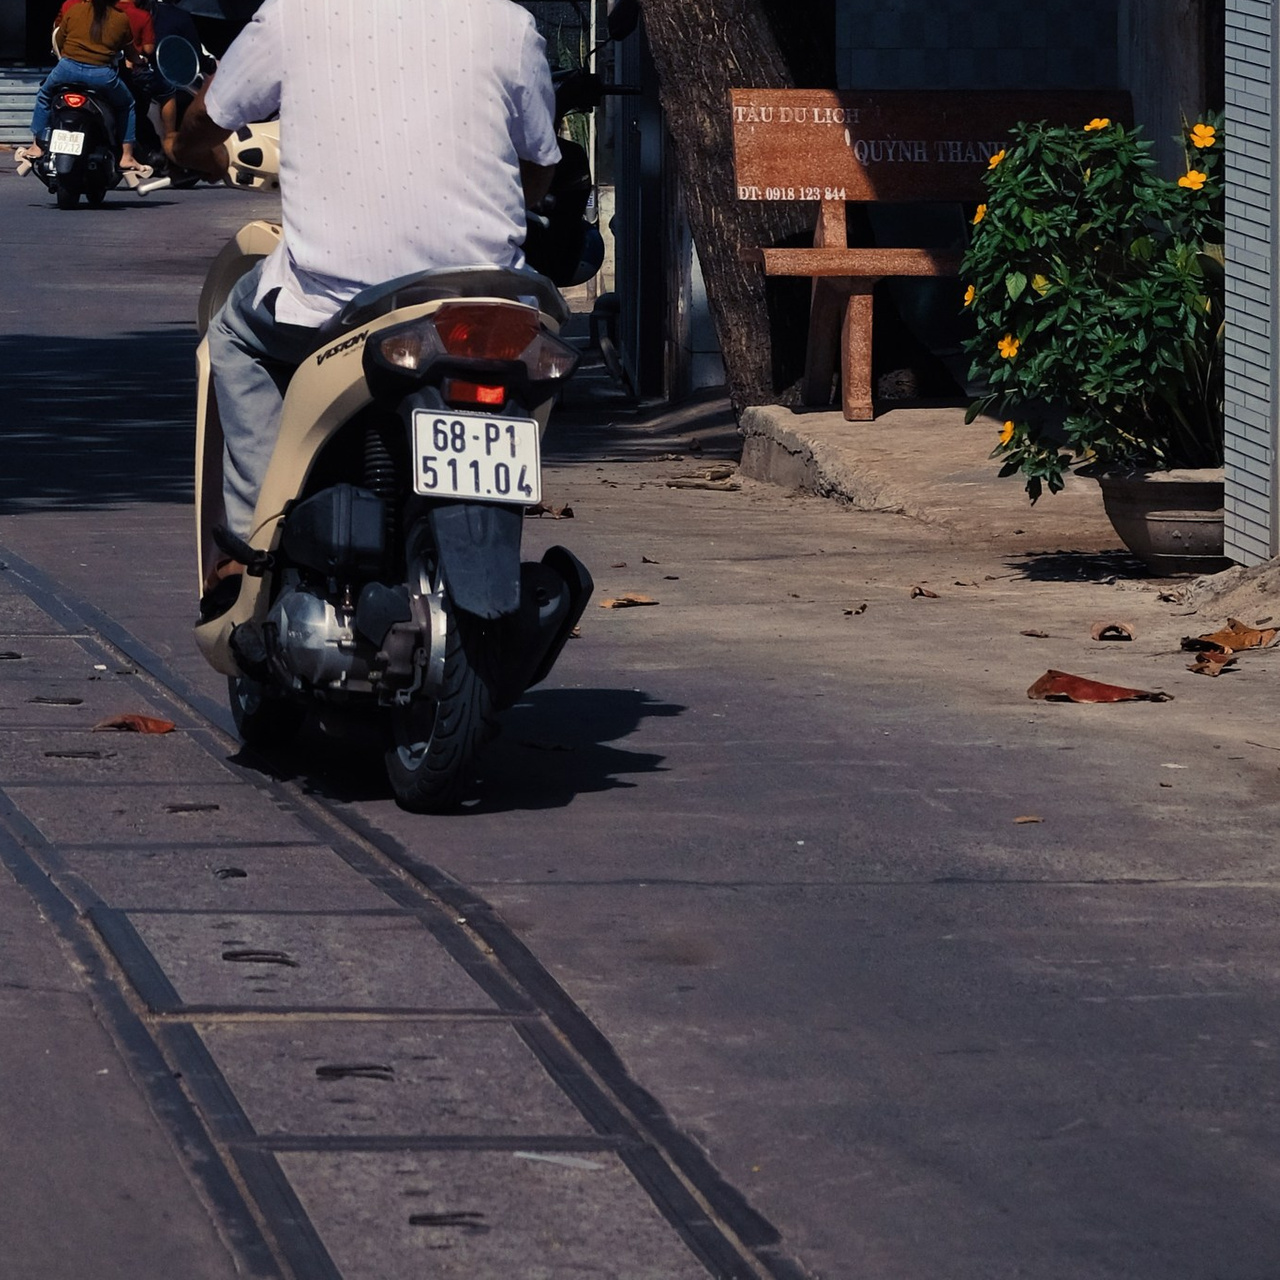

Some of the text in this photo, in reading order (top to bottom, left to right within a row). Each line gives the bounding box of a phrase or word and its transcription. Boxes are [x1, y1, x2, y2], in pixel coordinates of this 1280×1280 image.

[734, 102, 860, 127] TÀU DU LỊCH
[854, 133, 928, 166] QUỲNH
[739, 187, 846, 200] ĐT: 0918 123 844
[316, 329, 369, 366] VISION
[432, 418, 516, 458] 68-P1
[422, 455, 533, 498] 511.04
